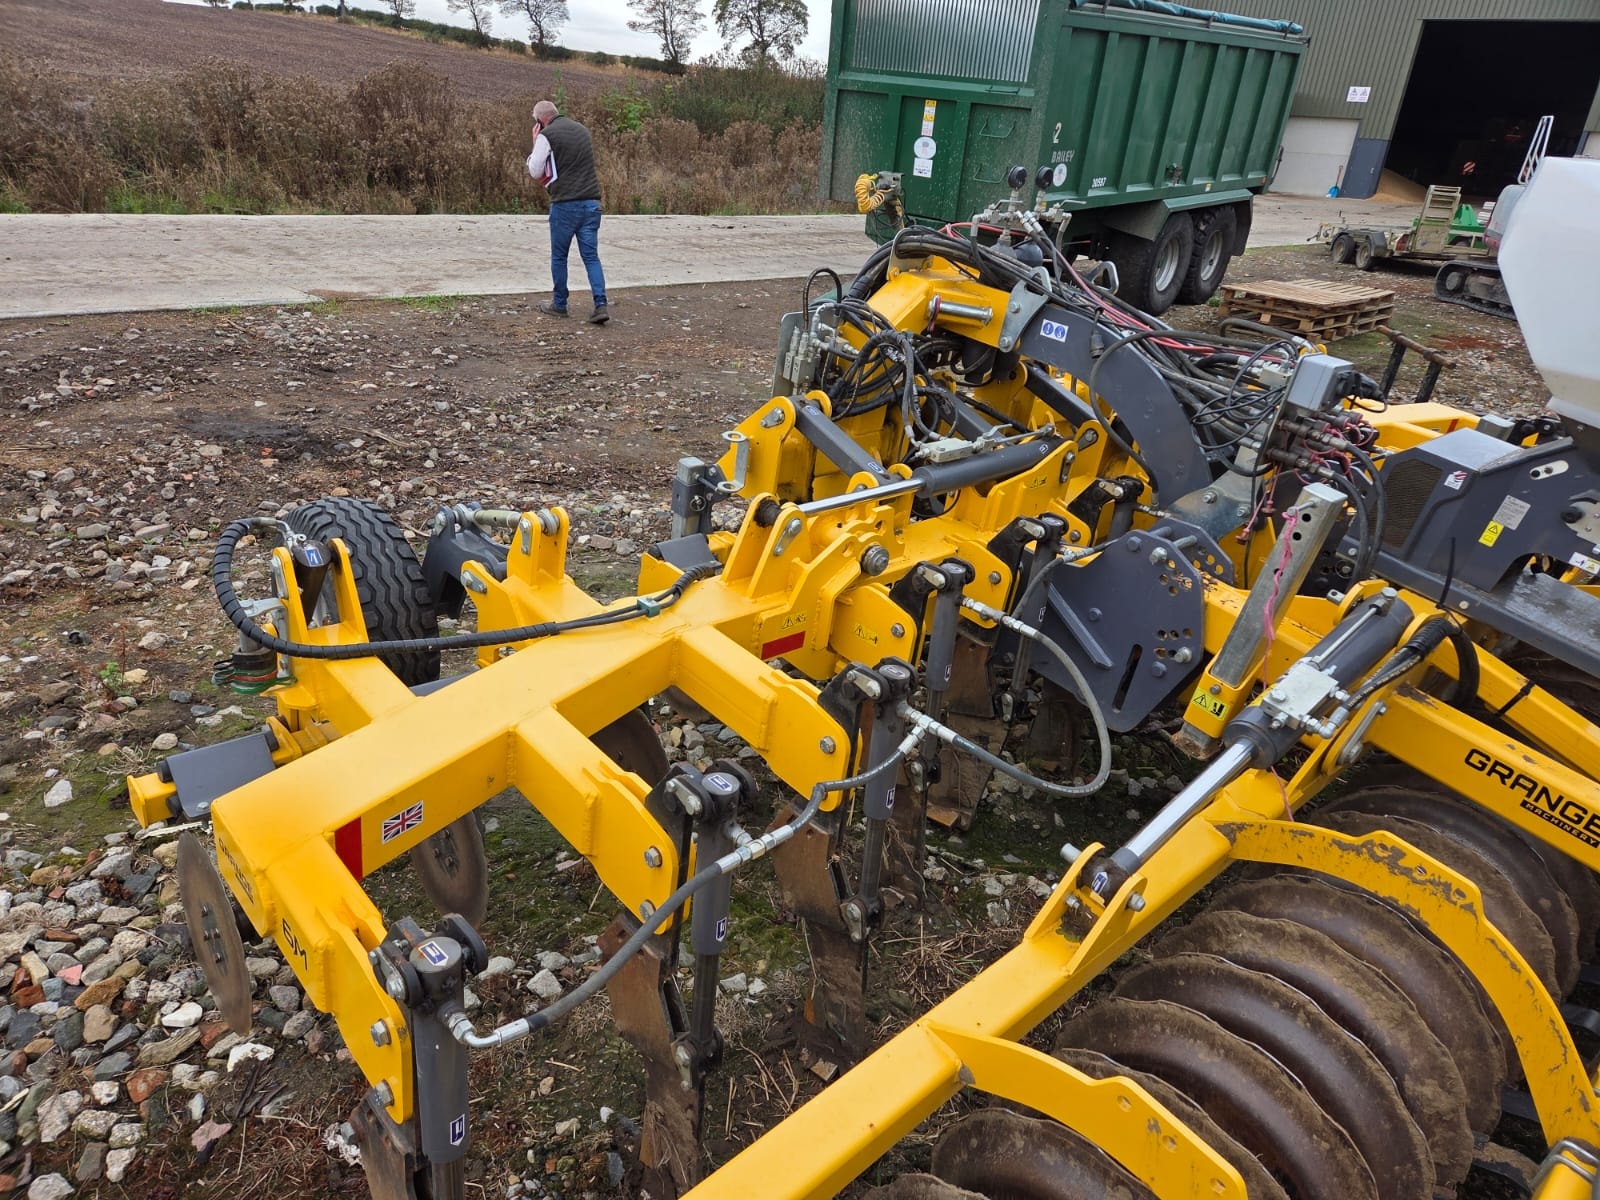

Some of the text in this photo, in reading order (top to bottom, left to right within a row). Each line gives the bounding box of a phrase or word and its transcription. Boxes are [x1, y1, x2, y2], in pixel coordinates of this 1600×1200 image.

[1053, 122, 1062, 143] 2
[1051, 149, 1075, 163] BAILEY
[1464, 748, 1600, 840] GRANGE
[1525, 802, 1597, 846] MACHINERY
[282, 918, 308, 971] 6M
